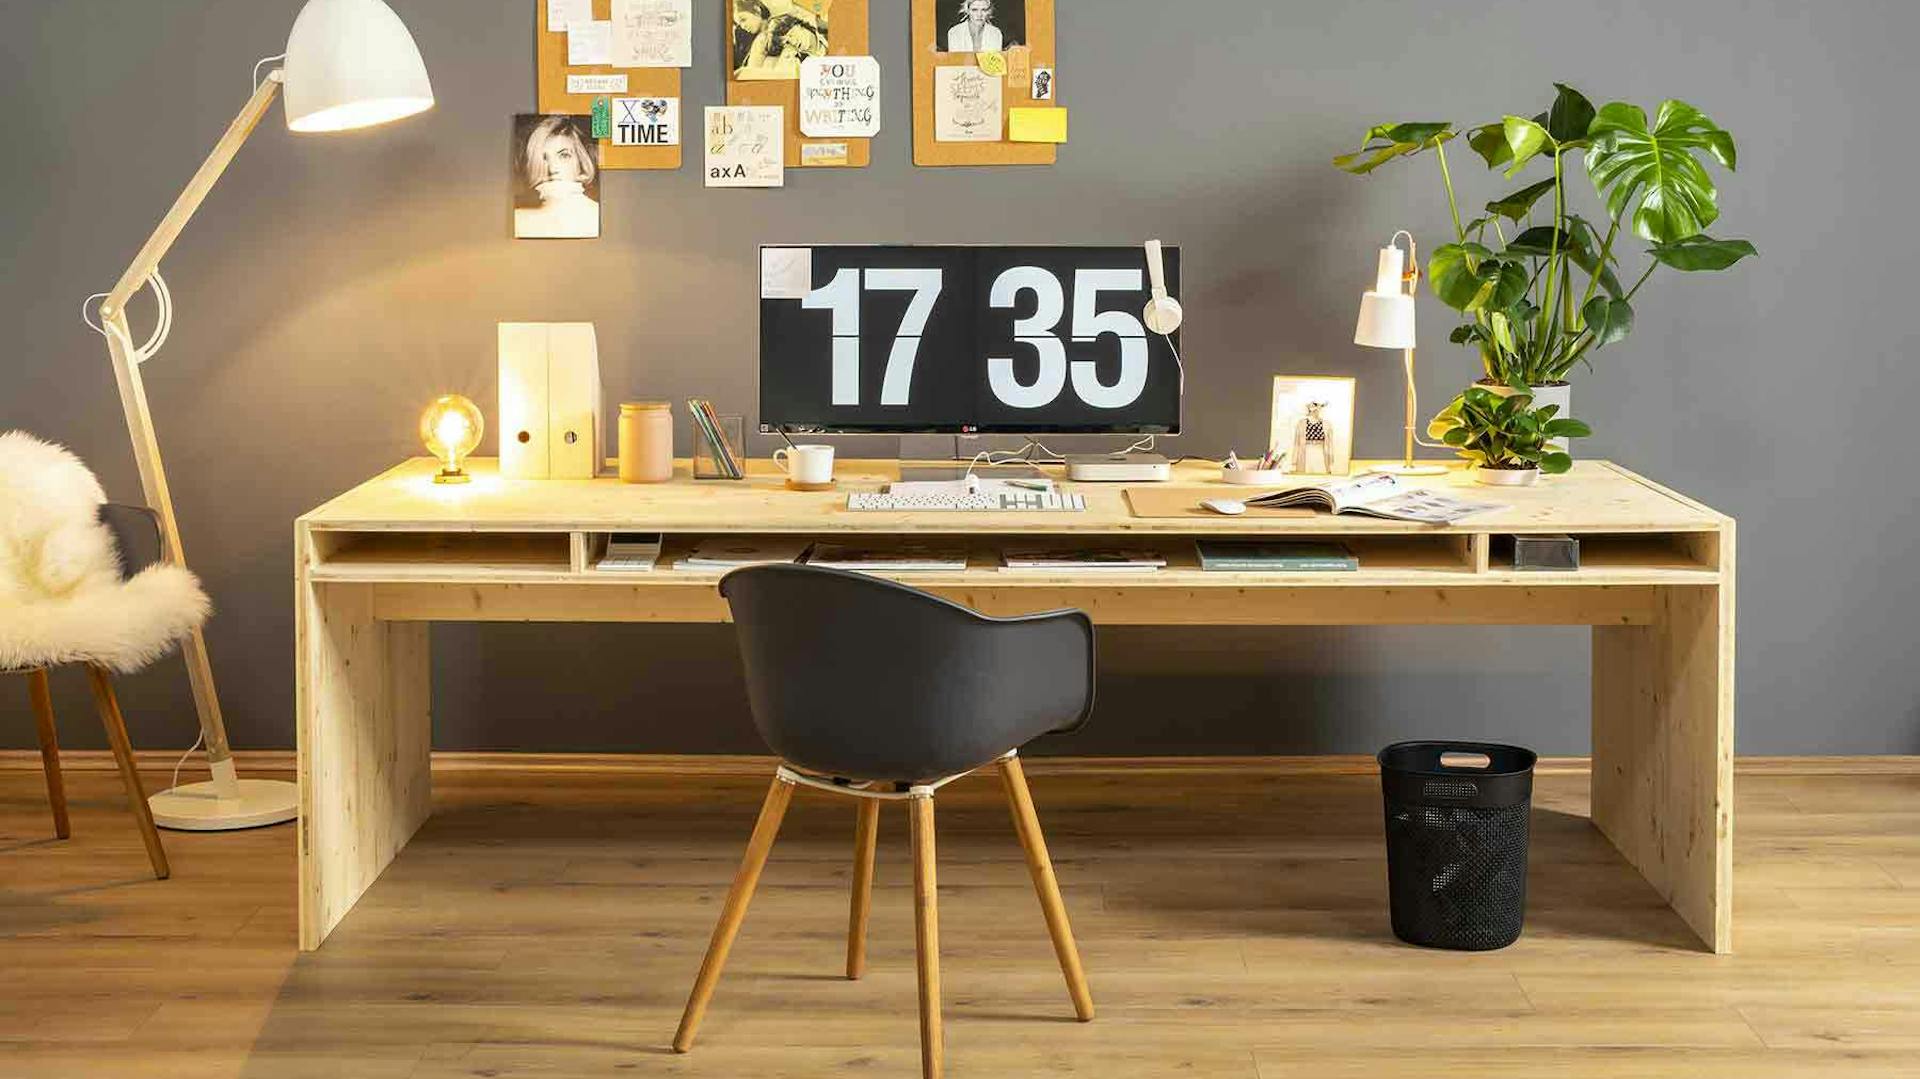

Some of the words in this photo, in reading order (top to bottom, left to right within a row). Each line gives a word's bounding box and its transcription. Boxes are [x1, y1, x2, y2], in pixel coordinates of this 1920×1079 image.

[819, 64, 856, 78] YOU
[618, 125, 669, 143] TIME
[801, 268, 943, 406] 17
[987, 265, 1149, 409] 35
